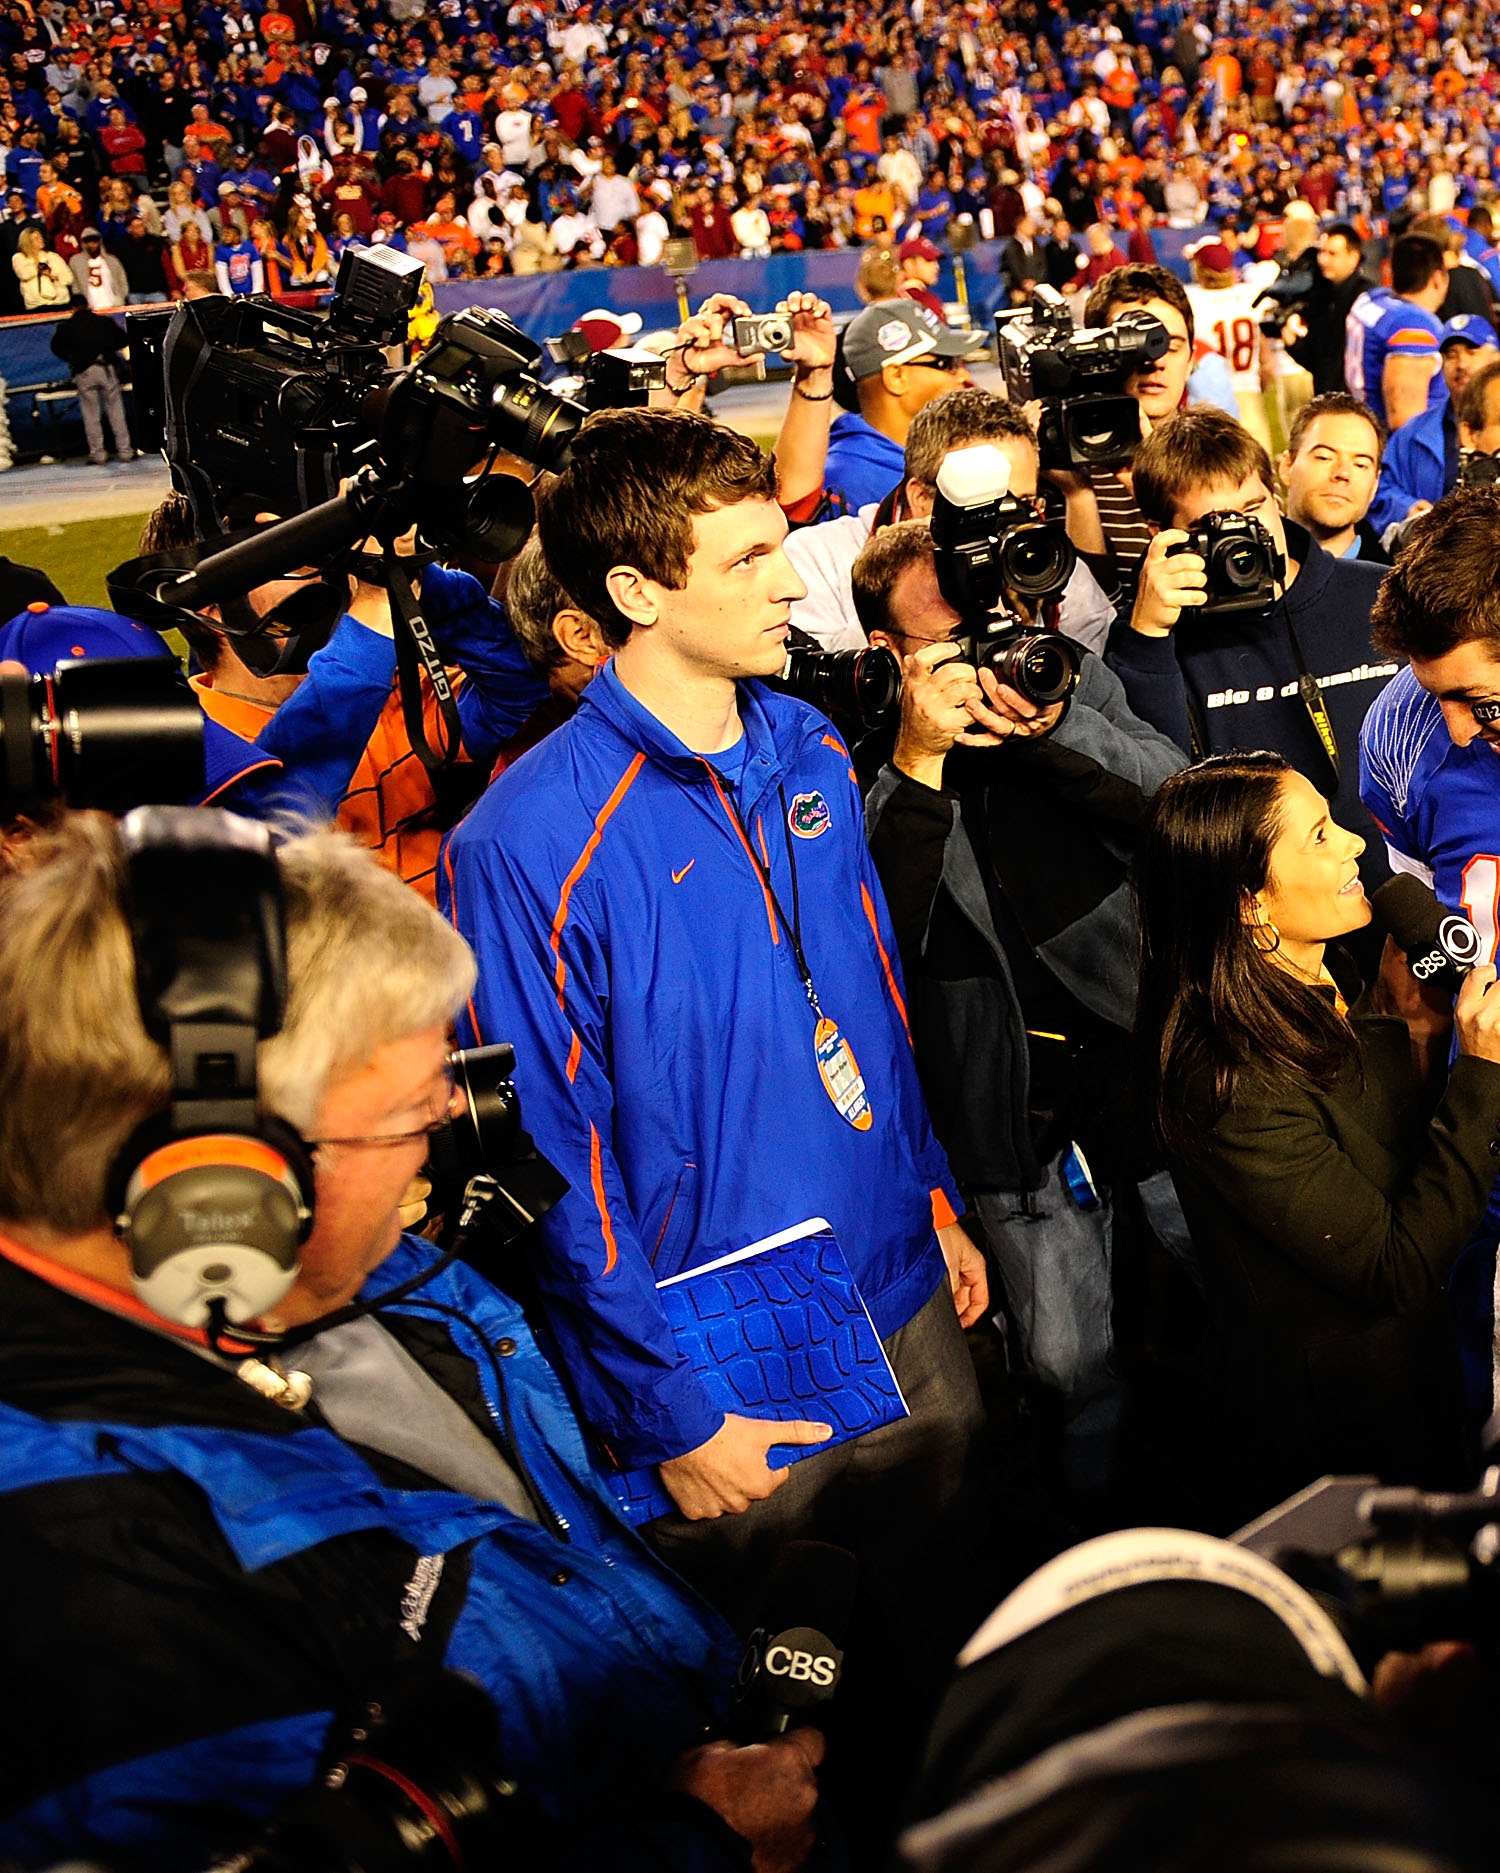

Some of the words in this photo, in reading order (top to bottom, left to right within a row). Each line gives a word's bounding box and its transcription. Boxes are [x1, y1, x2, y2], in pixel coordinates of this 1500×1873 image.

[1213, 317, 1254, 372] 18
[409, 615, 451, 701] GITZO
[1313, 711, 1336, 756] Nikon
[1412, 950, 1447, 979] CBS
[765, 1645, 836, 1687] CBS
